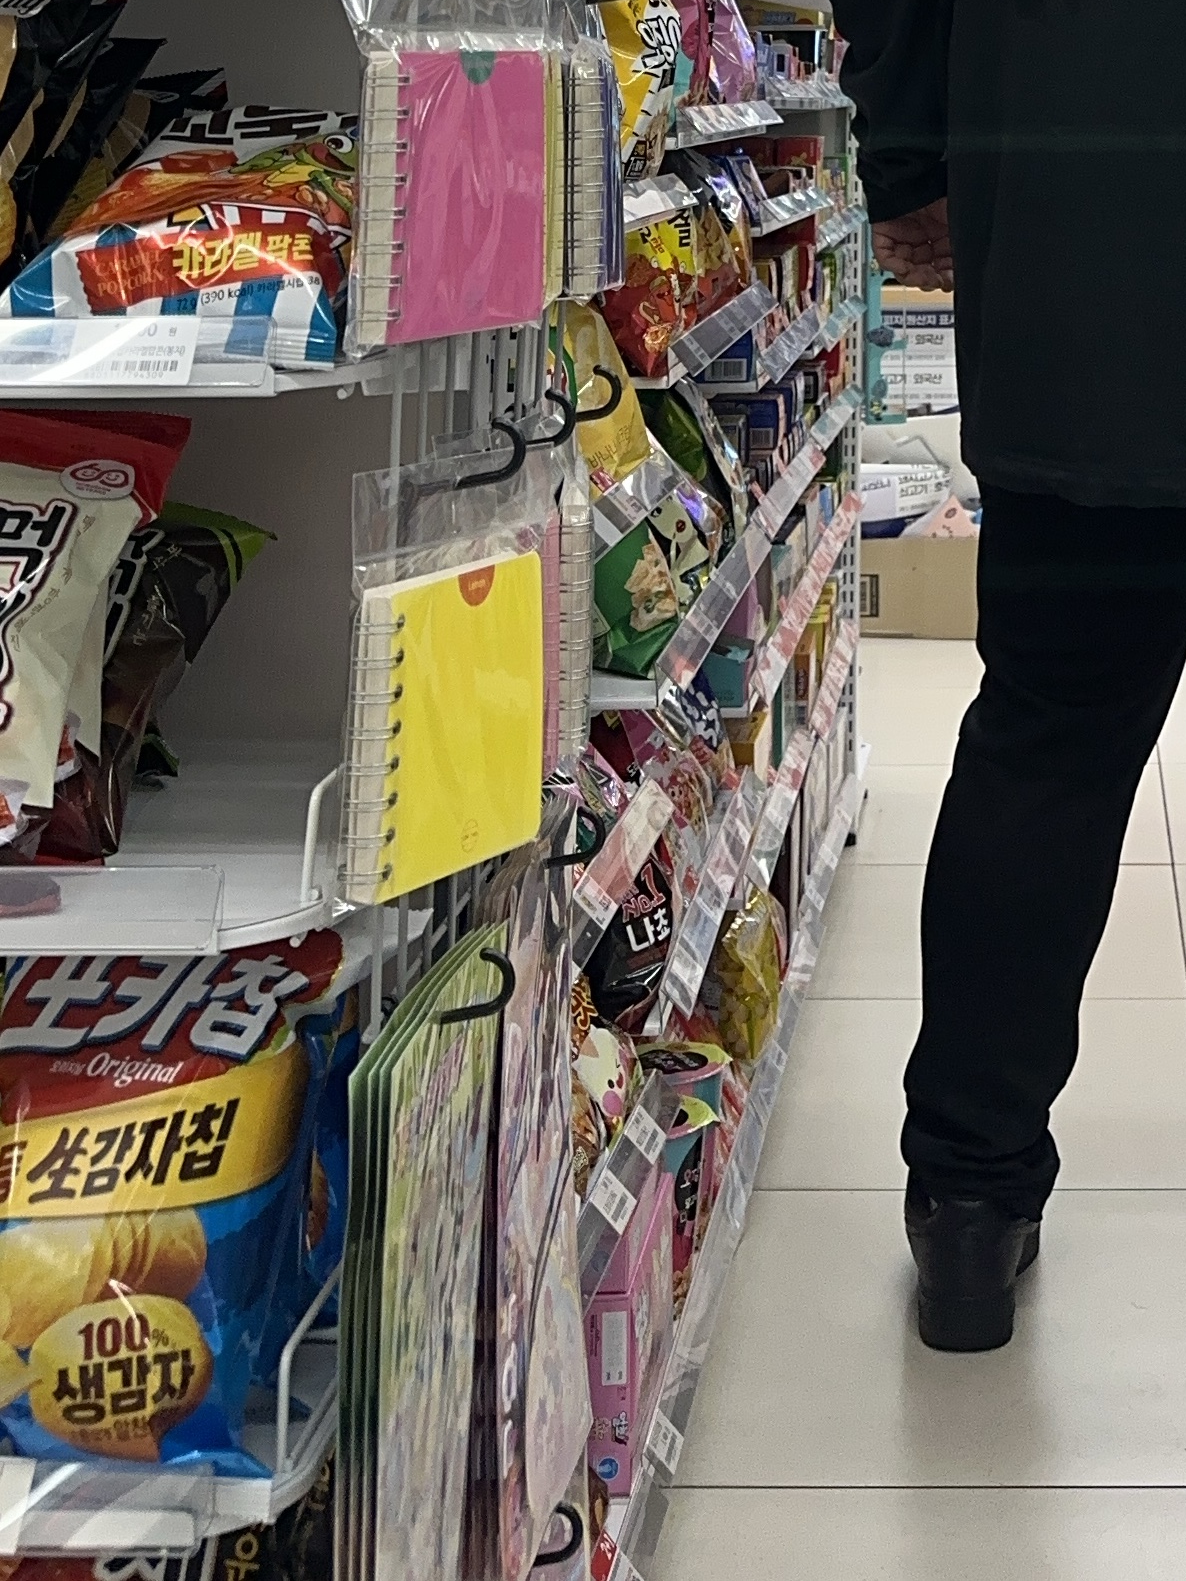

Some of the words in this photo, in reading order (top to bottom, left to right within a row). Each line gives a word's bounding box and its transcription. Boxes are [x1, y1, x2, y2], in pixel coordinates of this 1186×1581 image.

[172, 231, 263, 279] 카라멜
[265, 232, 314, 266] 팝콘
[915, 333, 943, 345] 외국산
[913, 372, 942, 385] 외국산
[85, 1050, 184, 1089] Original
[52, 1348, 195, 1427] 생감자
